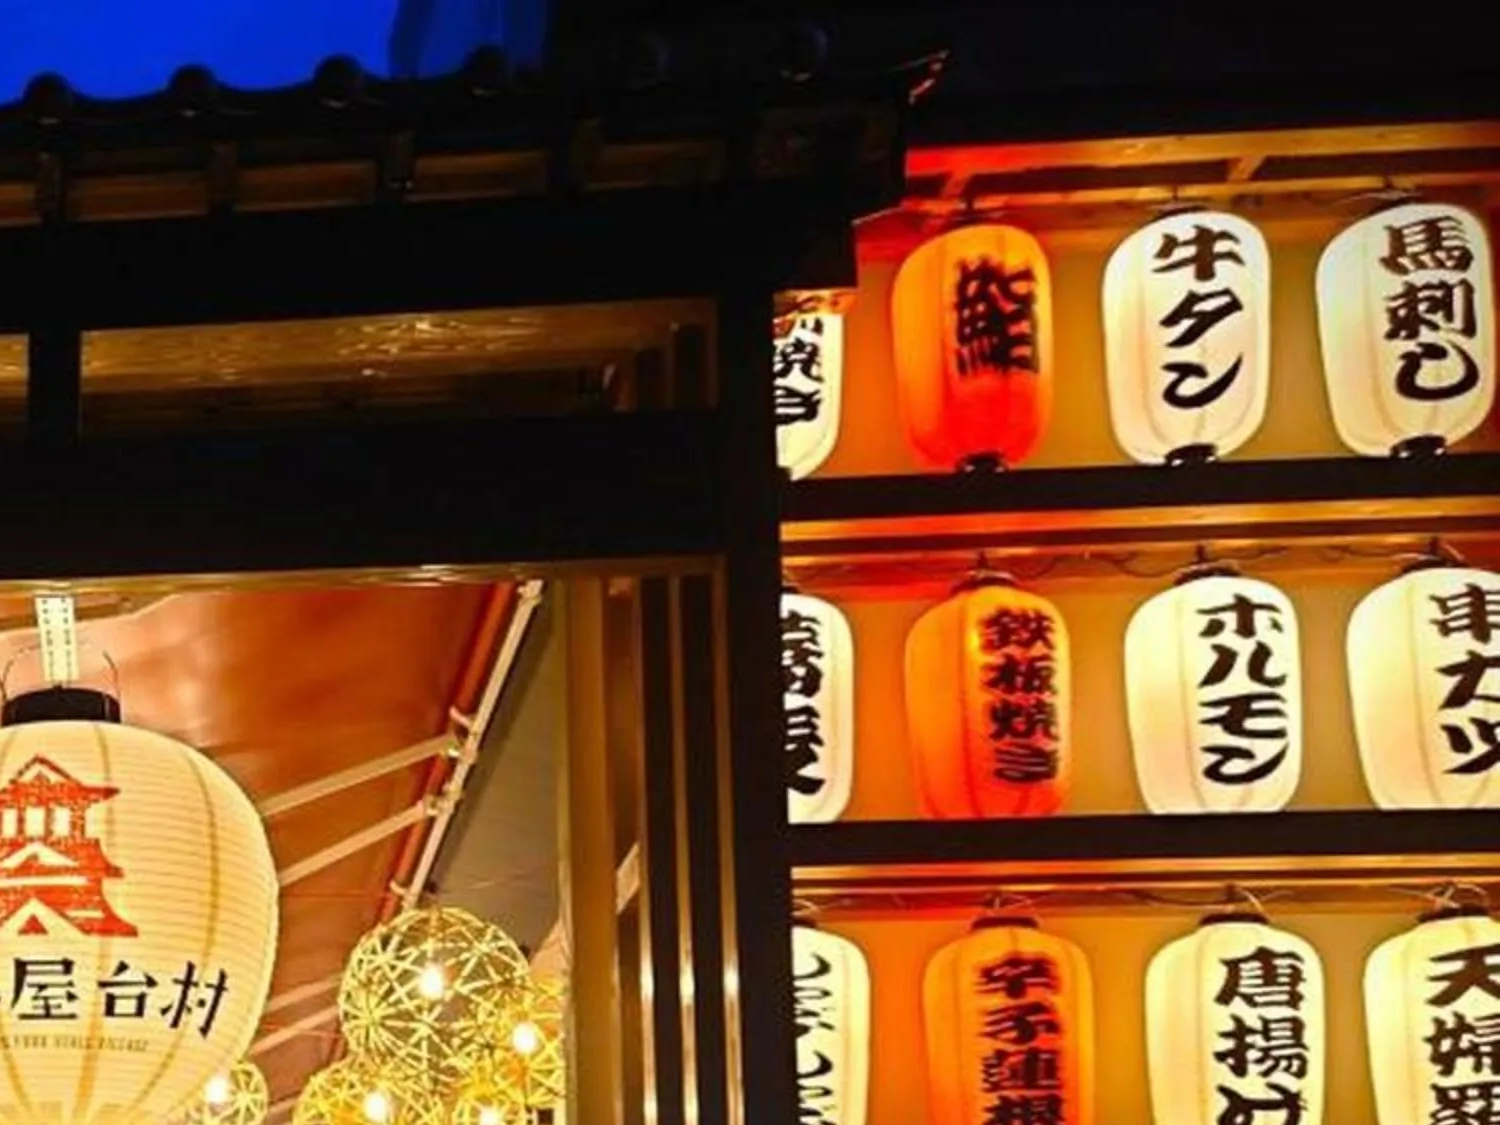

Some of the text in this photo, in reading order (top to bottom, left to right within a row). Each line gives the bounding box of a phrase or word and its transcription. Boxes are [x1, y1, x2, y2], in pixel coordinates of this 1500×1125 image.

[1151, 224, 1246, 410] 牛タン
[1379, 215, 1480, 402] 馬刺し
[981, 605, 1060, 784] 鉄板焼き
[1196, 593, 1291, 785] ホルモン
